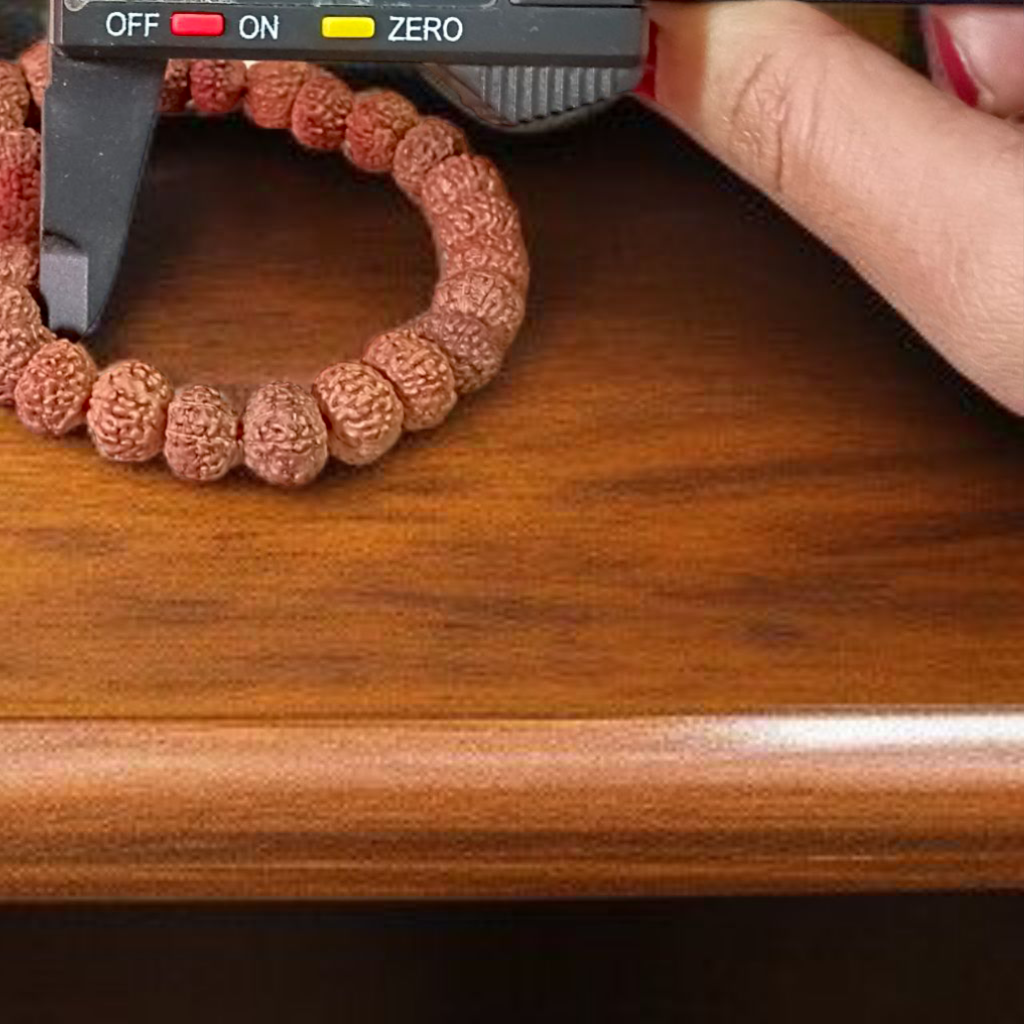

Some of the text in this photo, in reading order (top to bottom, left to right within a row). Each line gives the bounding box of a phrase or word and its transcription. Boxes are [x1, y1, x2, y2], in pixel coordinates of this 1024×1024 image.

[105, 11, 280, 40] OFF ON
[387, 15, 463, 42] ZERO
